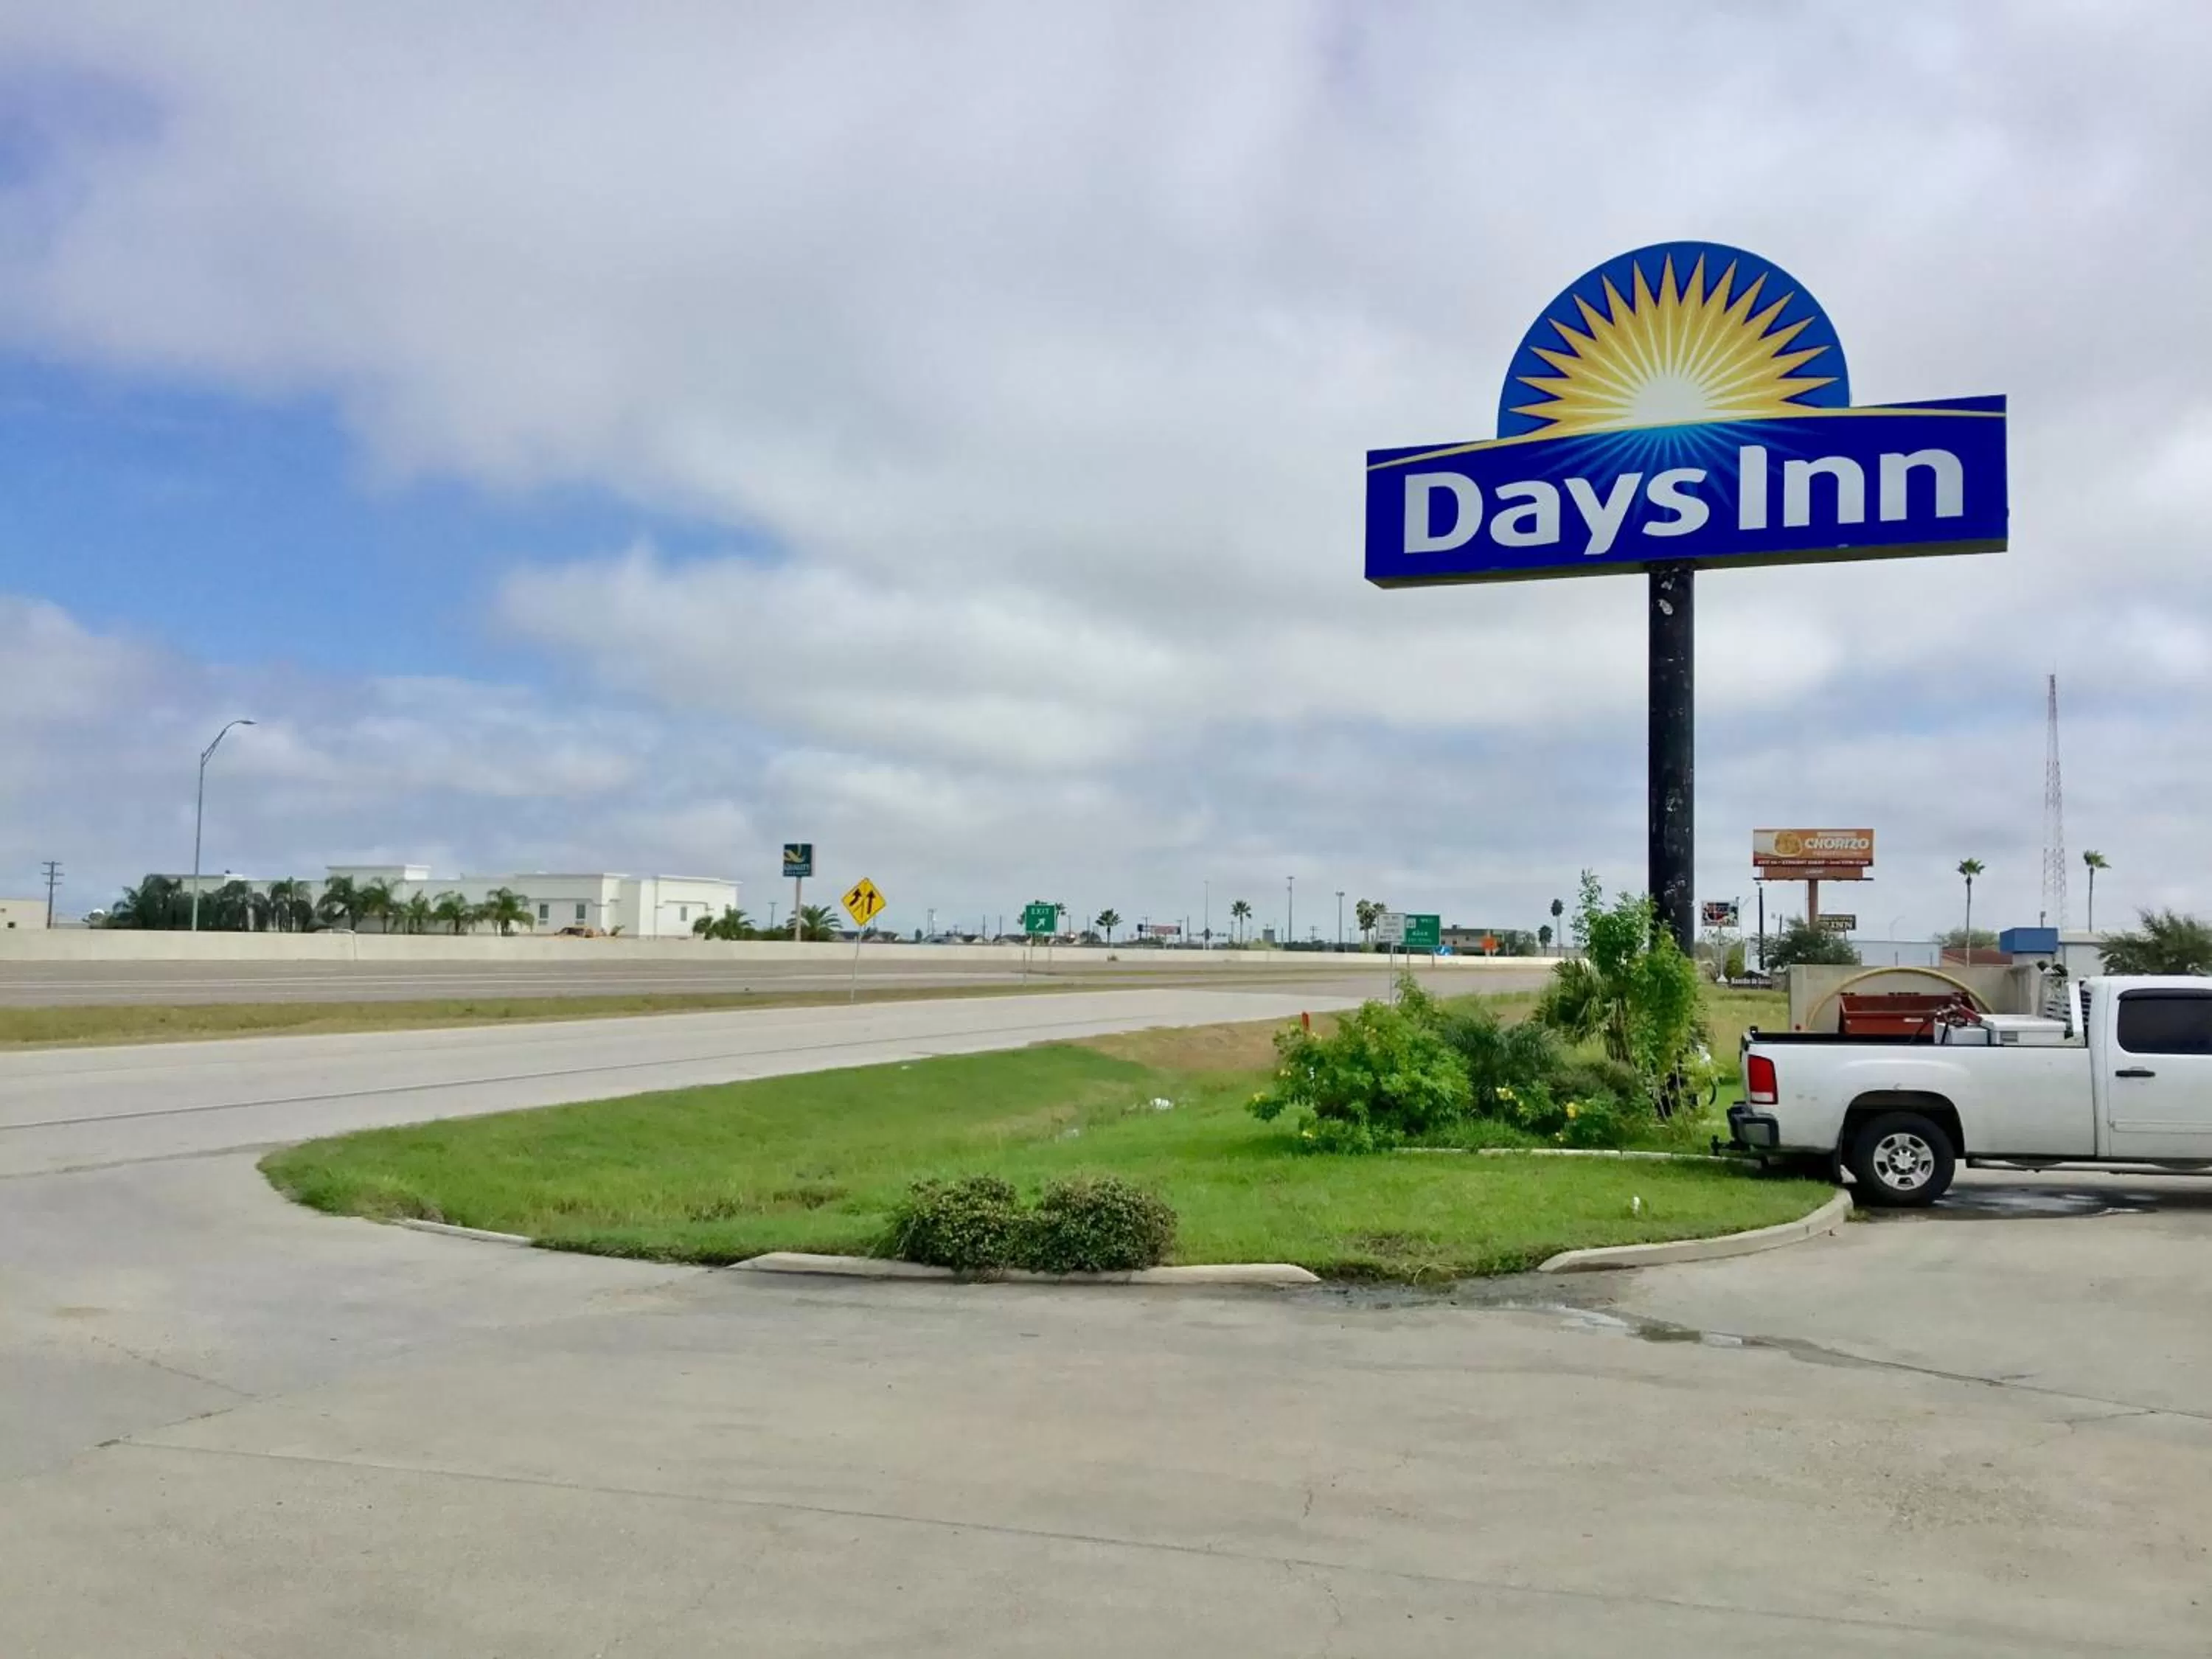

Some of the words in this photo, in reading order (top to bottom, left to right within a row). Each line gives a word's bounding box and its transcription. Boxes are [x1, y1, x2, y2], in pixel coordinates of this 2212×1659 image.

[1404, 467, 1710, 555] Days
[1739, 445, 1964, 530] Inn
[1804, 837, 1870, 849] CHORIZO
